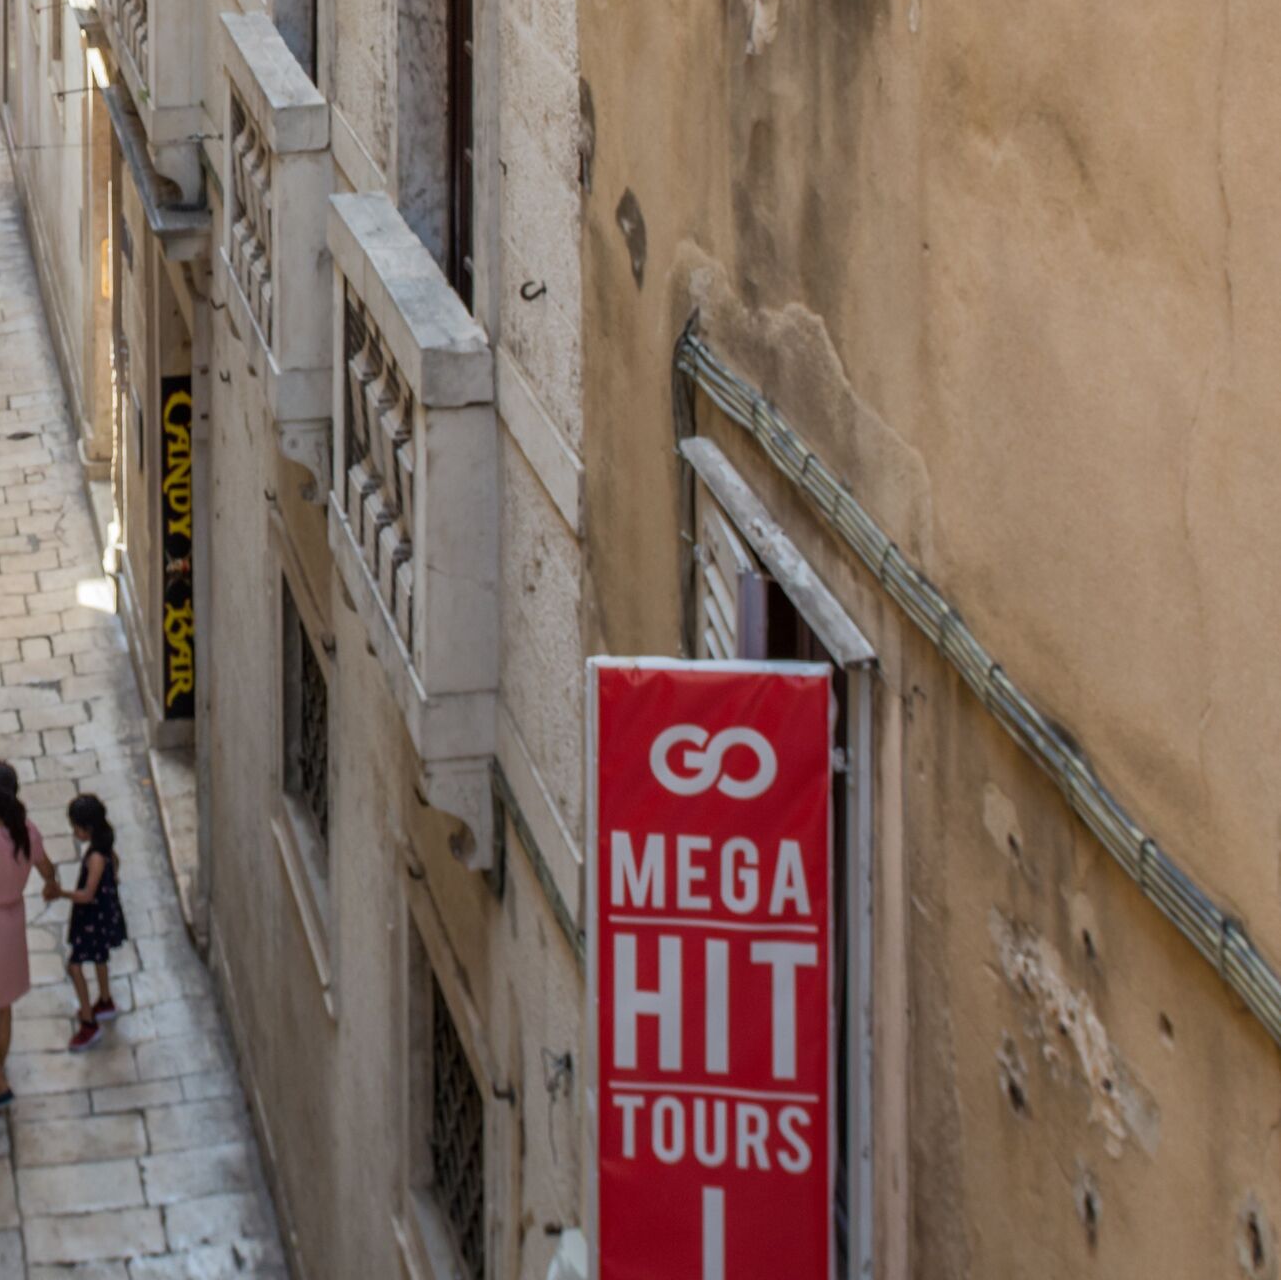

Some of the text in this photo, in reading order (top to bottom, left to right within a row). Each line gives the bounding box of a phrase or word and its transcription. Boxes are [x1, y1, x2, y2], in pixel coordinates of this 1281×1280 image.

[162, 389, 195, 709] CANDY BAR
[649, 723, 778, 800] GO
[610, 829, 811, 916] MEGA
[613, 933, 818, 1080] HIT
[611, 1094, 813, 1173] TOURS
